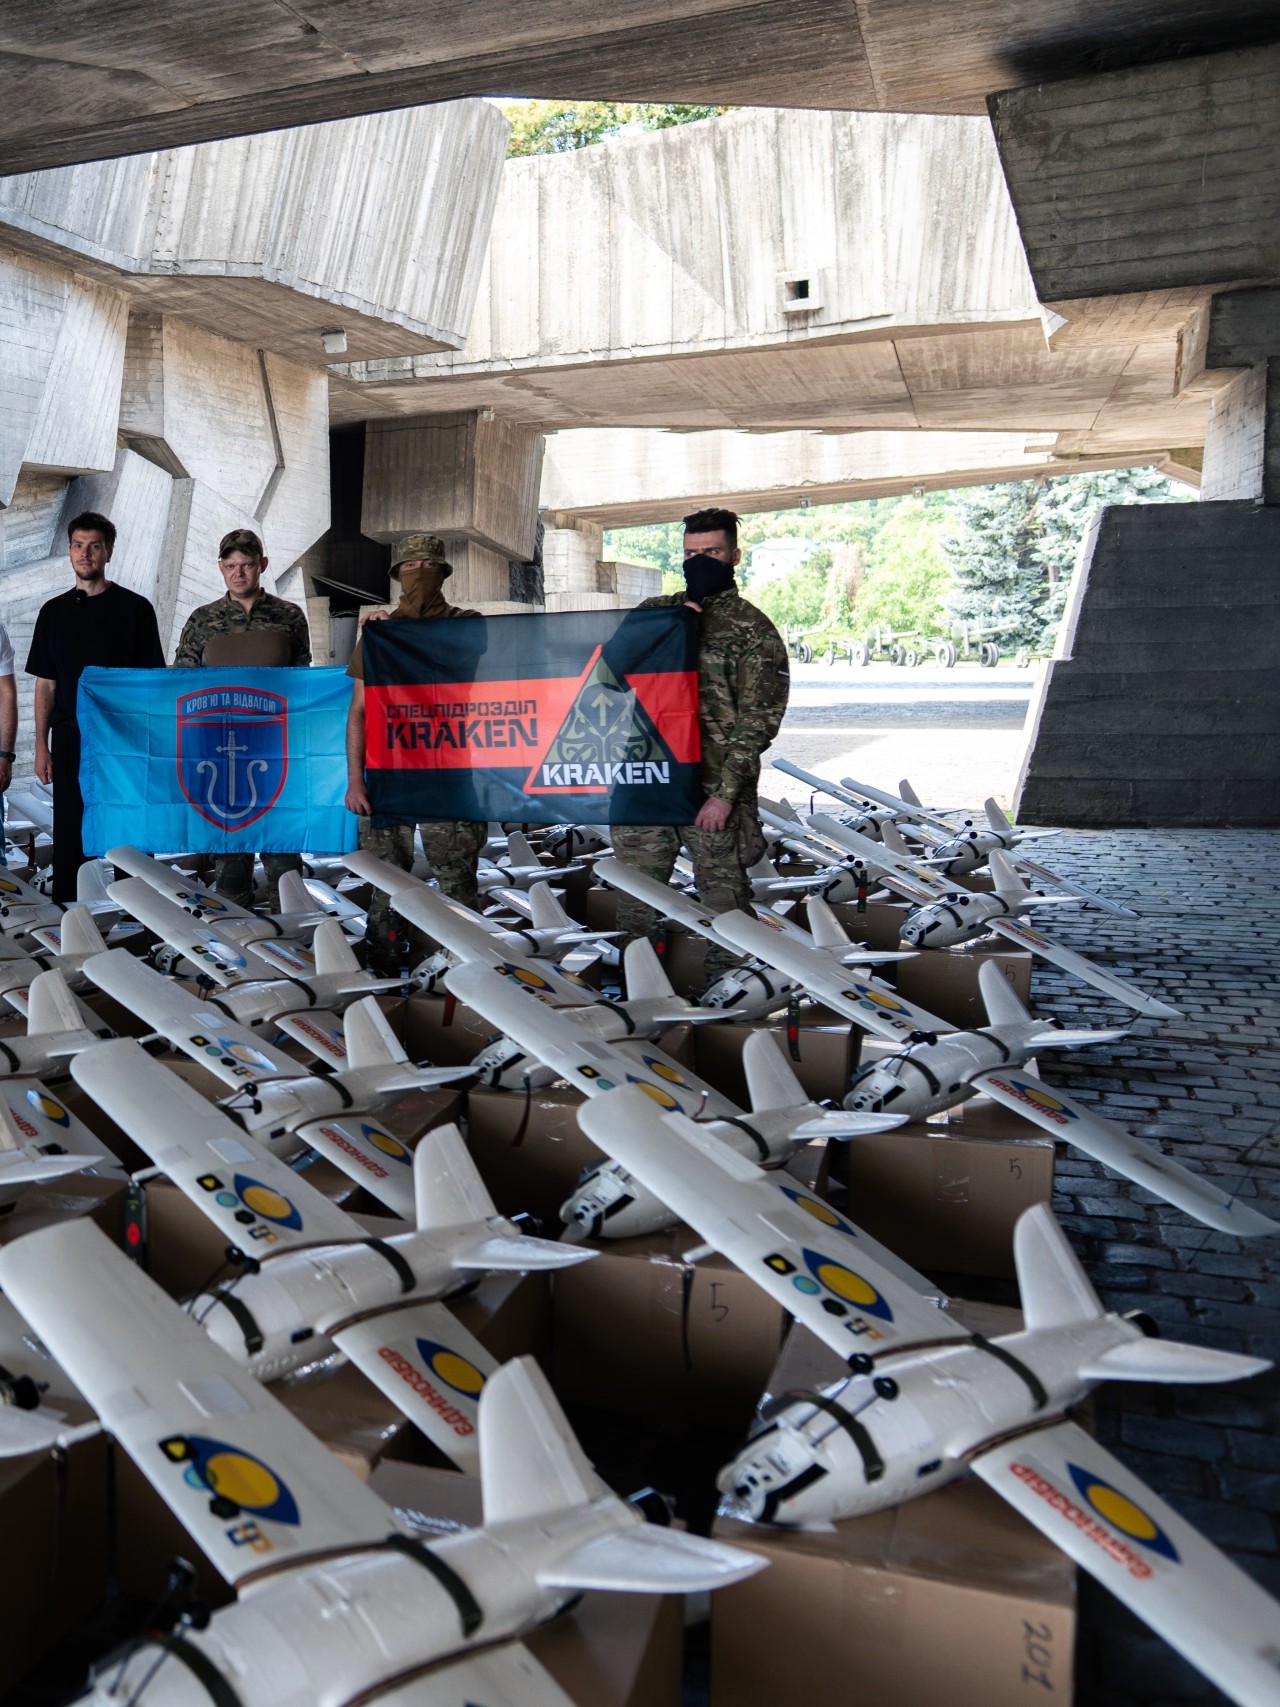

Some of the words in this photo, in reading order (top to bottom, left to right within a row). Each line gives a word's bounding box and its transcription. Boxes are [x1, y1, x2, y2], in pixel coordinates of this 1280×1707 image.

[221, 692, 231, 706] ТА
[234, 692, 277, 713] ВІДВАГОЮ
[386, 699, 538, 720] СПЕЦПІДРОЗДІЛ
[387, 718, 539, 750] KRAKEN
[542, 761, 671, 787] KRAKEN
[1004, 964, 1017, 983] 5
[1008, 1157, 1022, 1180] 5
[709, 1282, 730, 1323] 5
[377, 1346, 476, 1438] ЄДИНОЗБІР
